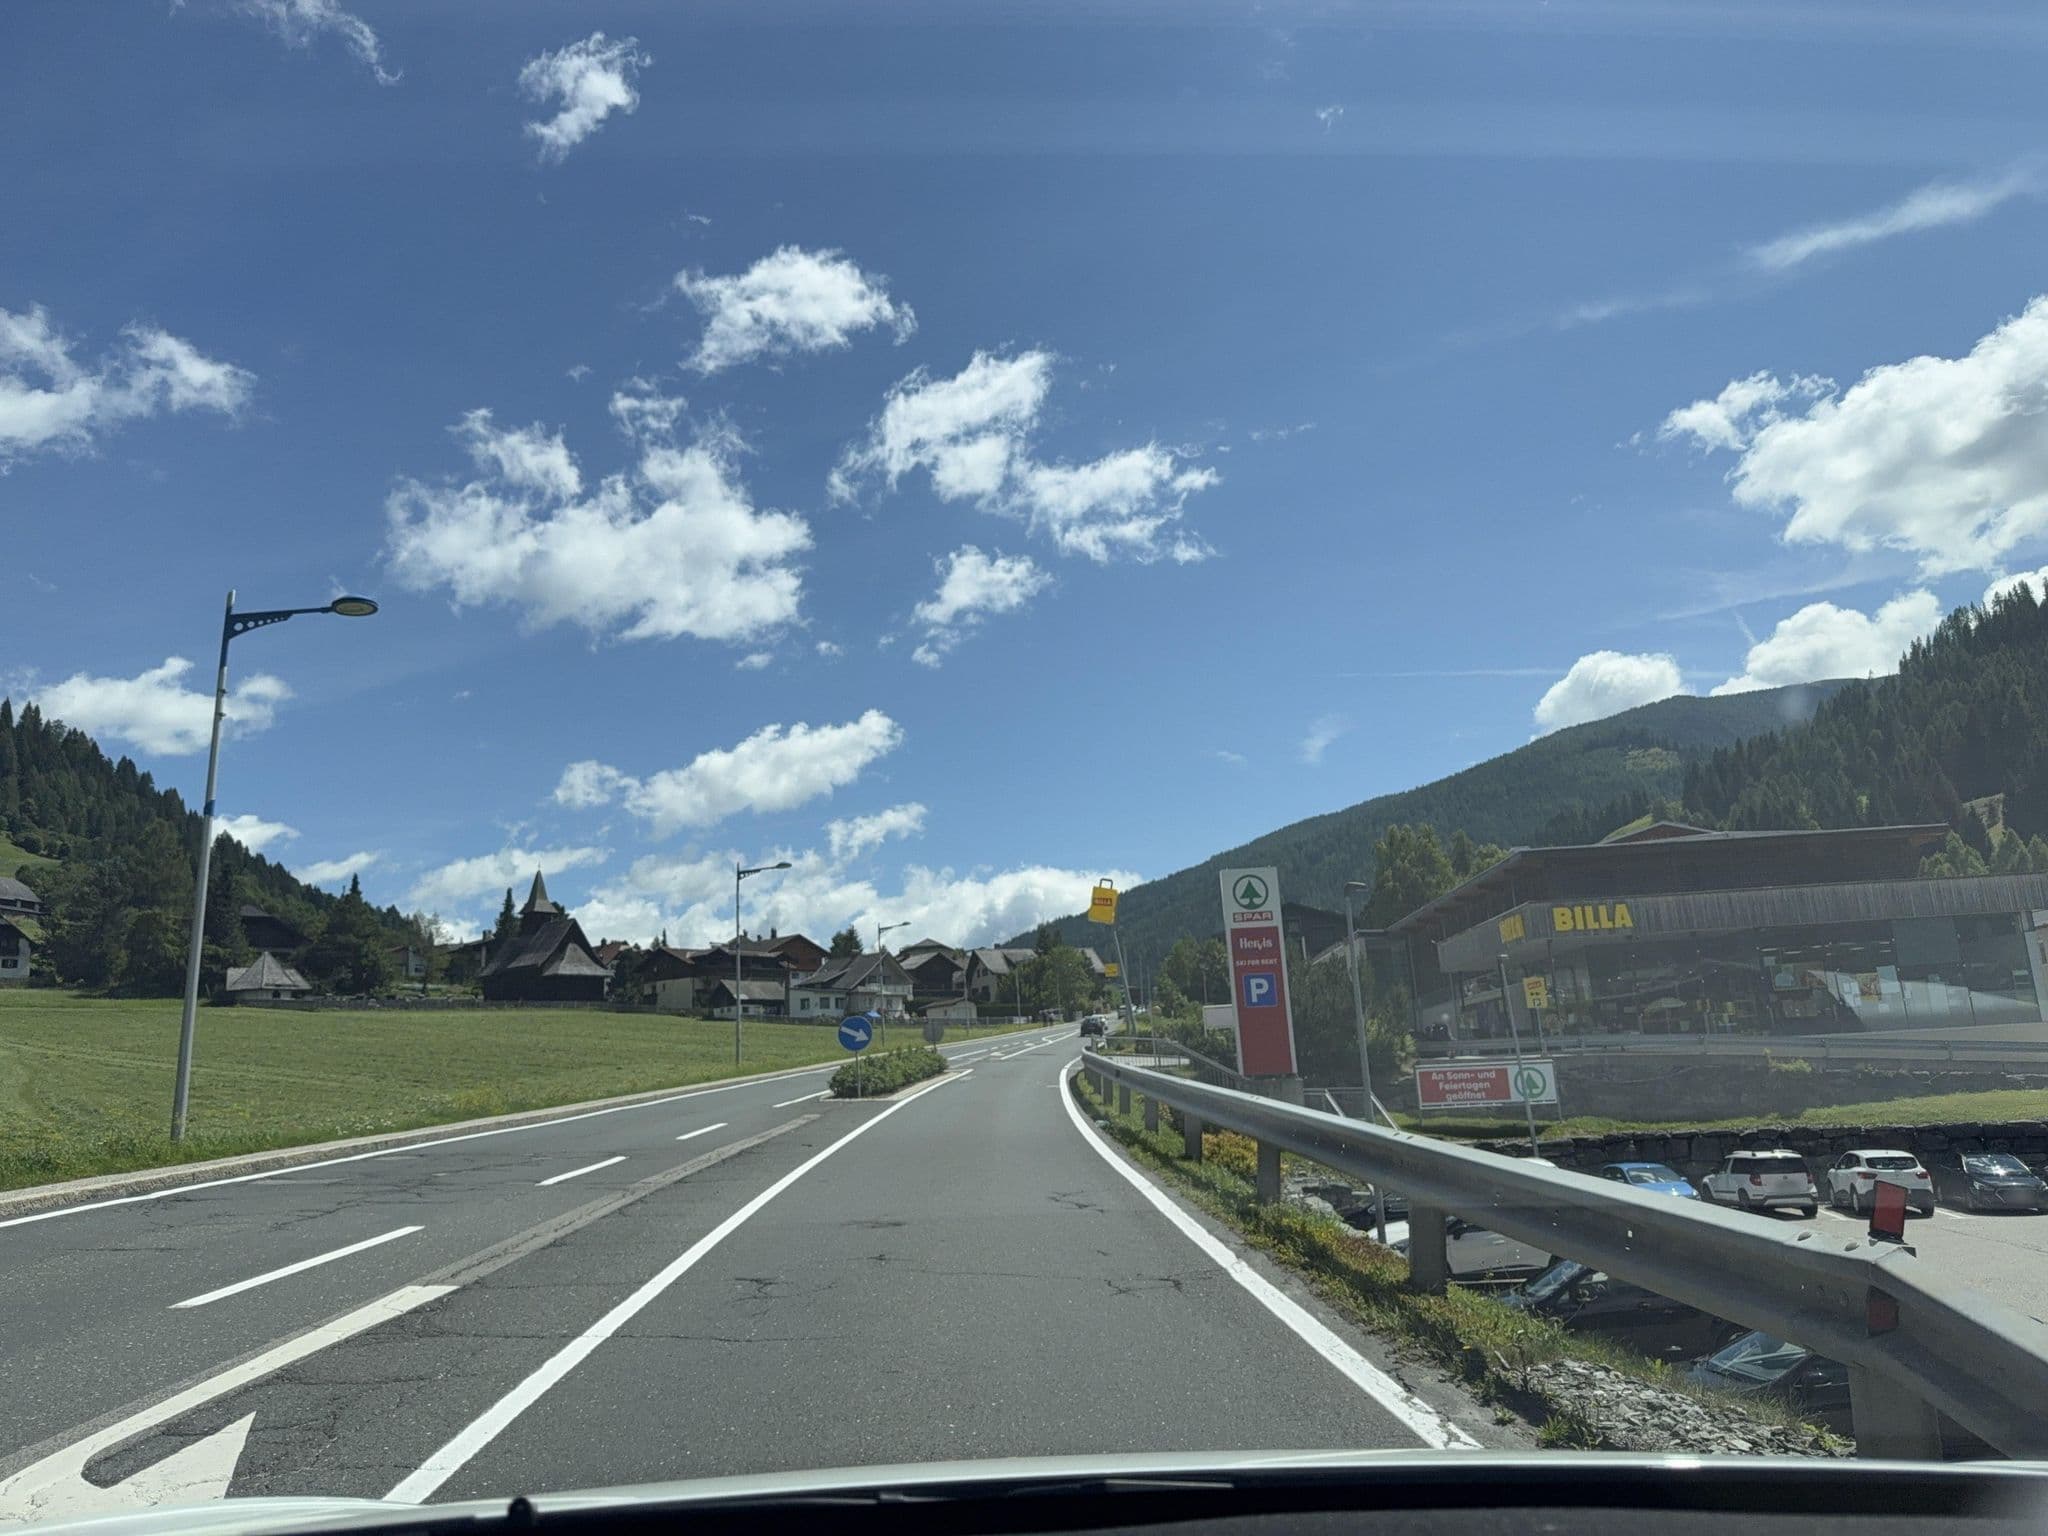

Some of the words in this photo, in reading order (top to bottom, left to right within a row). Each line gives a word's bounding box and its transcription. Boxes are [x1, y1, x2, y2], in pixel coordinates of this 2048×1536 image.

[1234, 912, 1272, 922] SPAR
[1552, 904, 1633, 931] BILLA
[1240, 937, 1273, 950] Hervis
[1250, 978, 1269, 1003] P
[1431, 1072, 1444, 1080] An
[1446, 1071, 1475, 1080] Sonn-
[1477, 1070, 1496, 1079] und
[1439, 1080, 1490, 1091] Feiertagen
[1446, 1091, 1486, 1102] geöffnet
